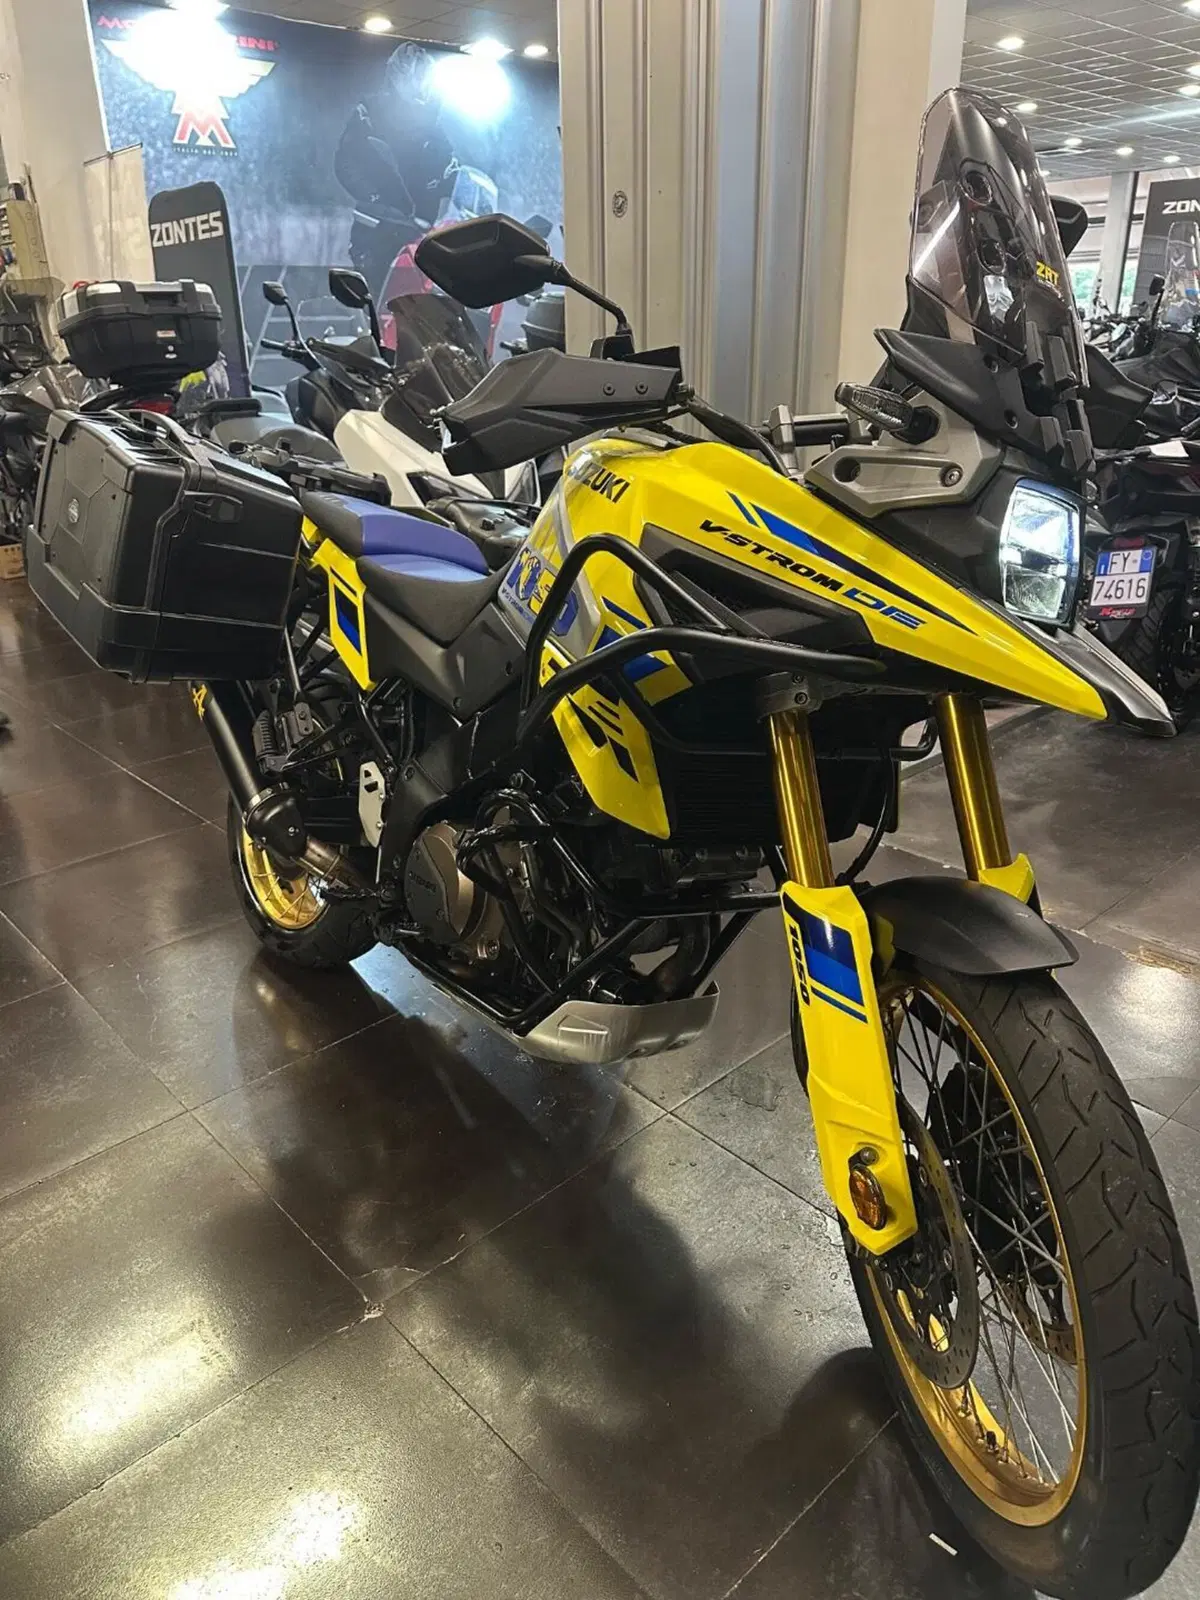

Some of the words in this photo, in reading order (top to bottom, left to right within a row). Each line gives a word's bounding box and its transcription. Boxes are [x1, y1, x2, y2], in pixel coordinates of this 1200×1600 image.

[150, 210, 224, 248] ZONTES
[699, 518, 845, 593] V-STROM
[842, 586, 928, 631] DE
[1108, 551, 1132, 573] FY
[1093, 578, 1147, 602] 74616
[788, 922, 811, 1007] 1050
